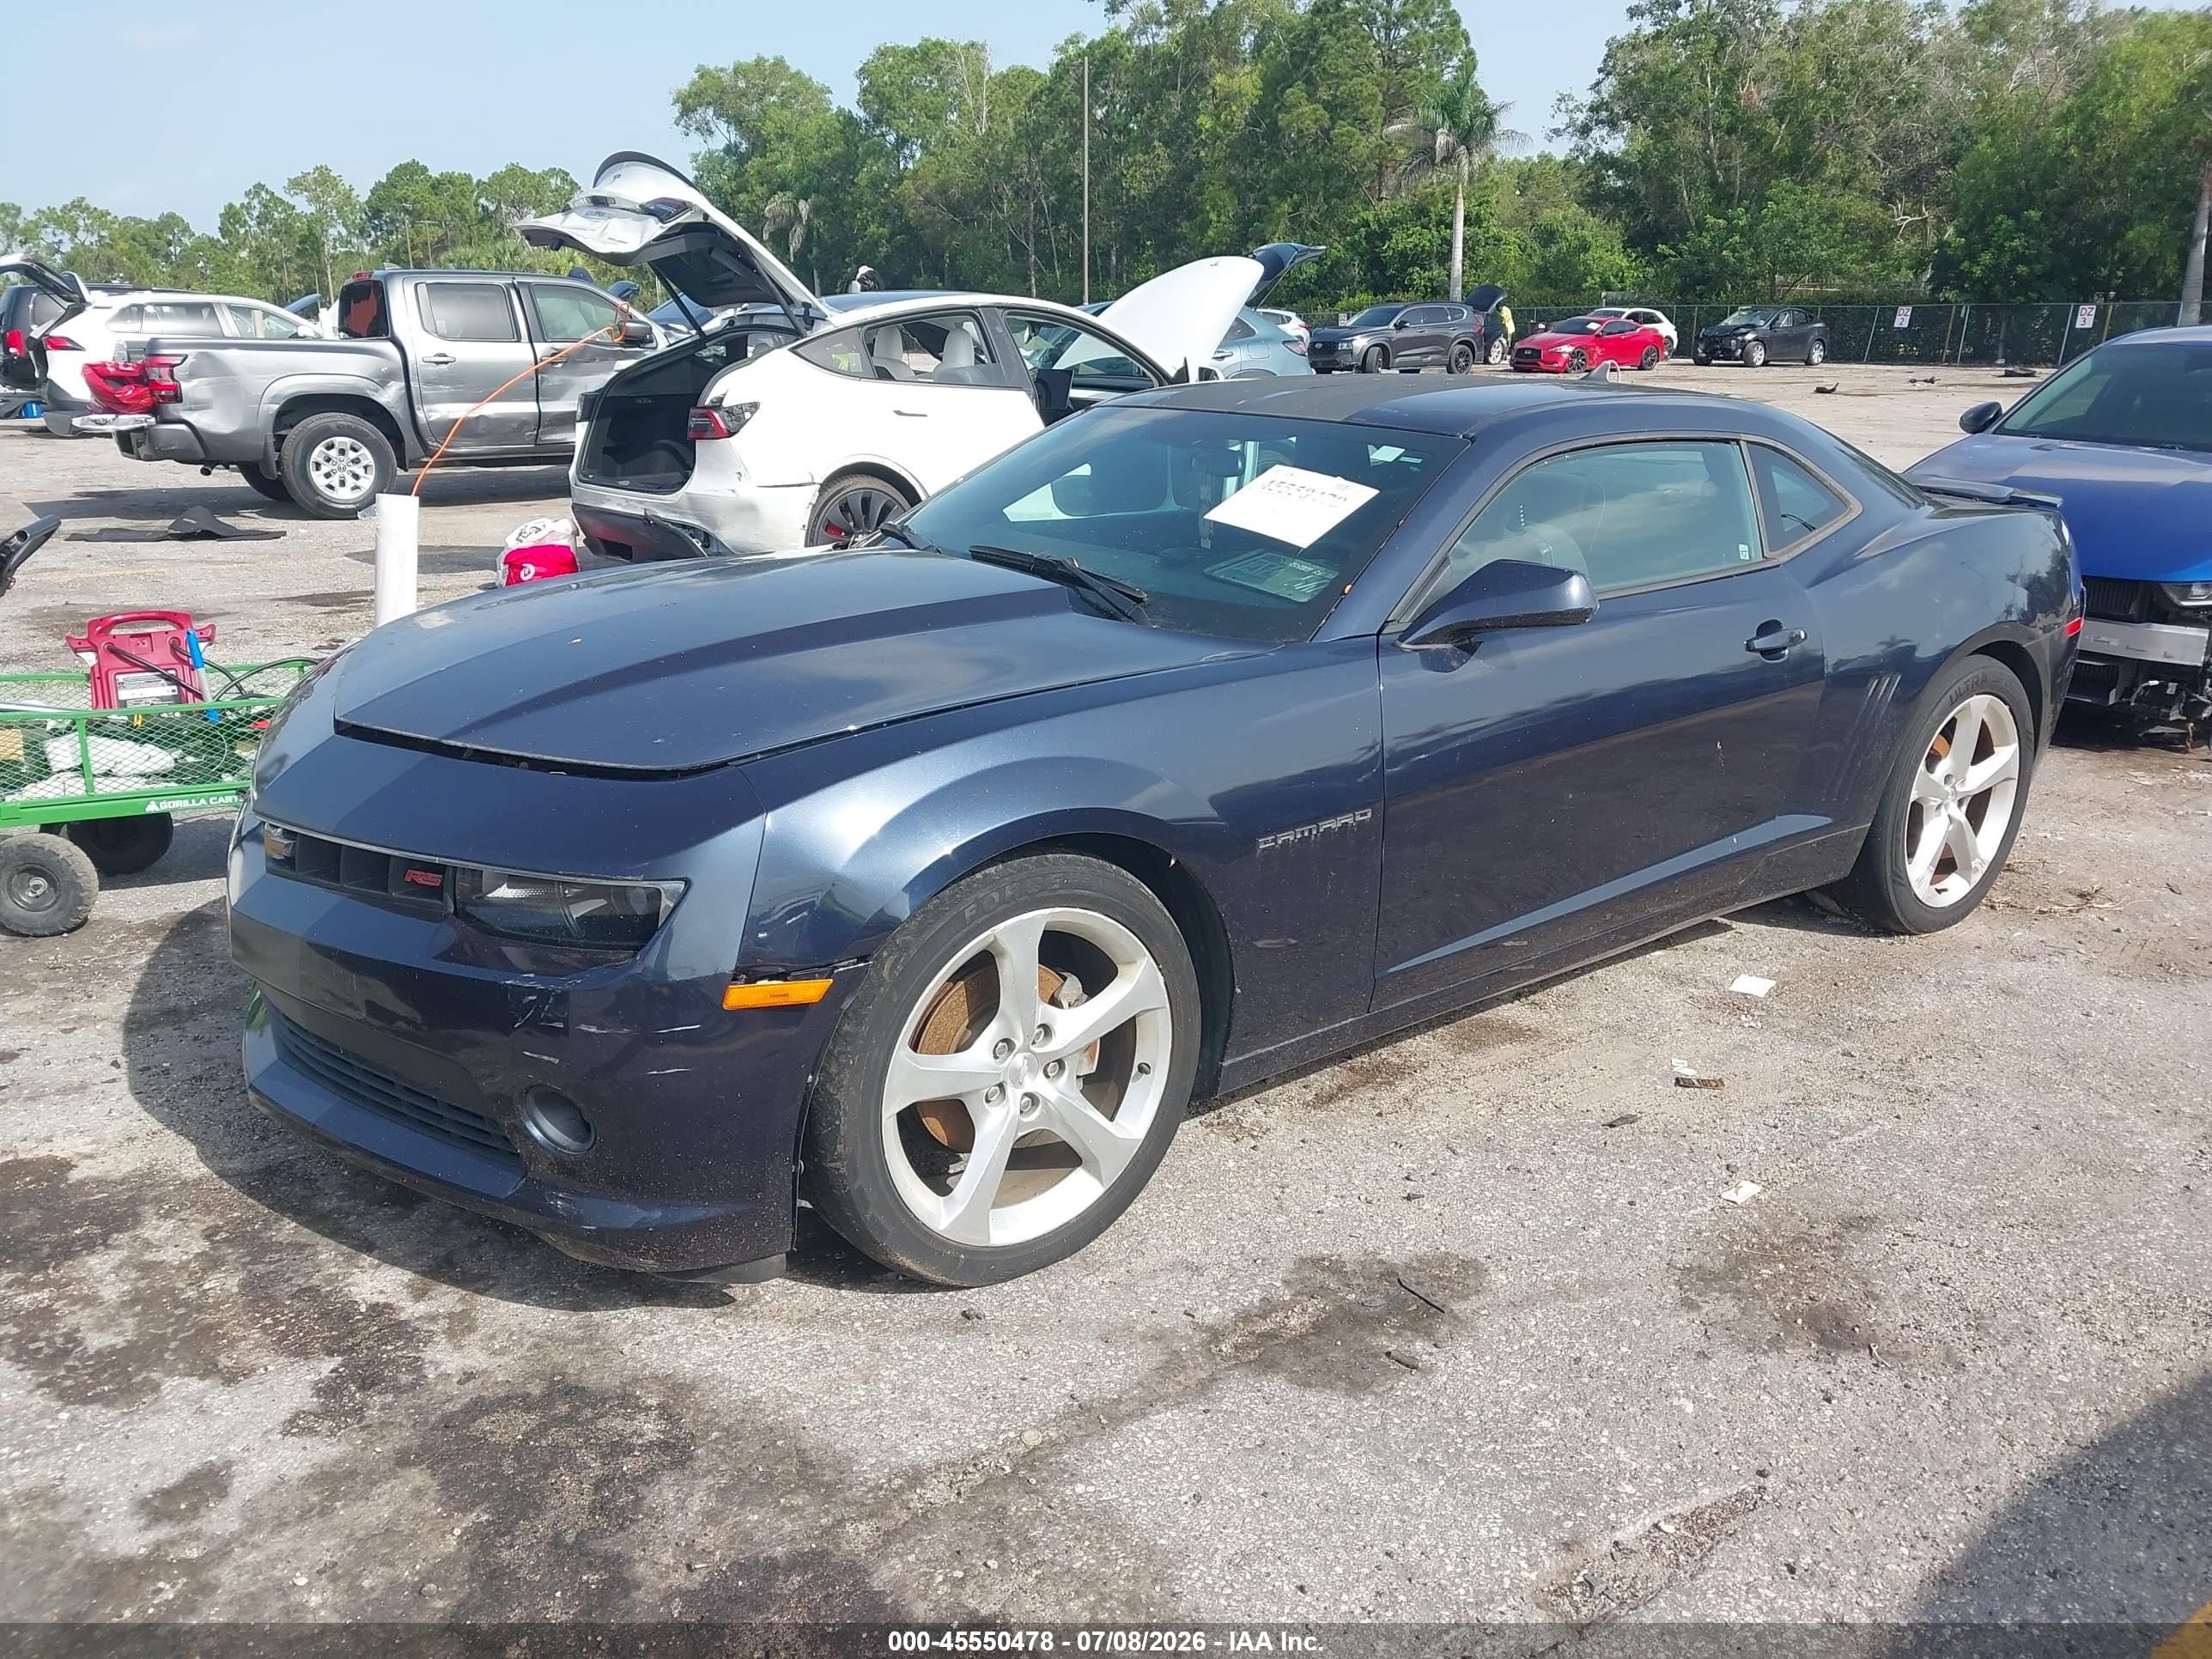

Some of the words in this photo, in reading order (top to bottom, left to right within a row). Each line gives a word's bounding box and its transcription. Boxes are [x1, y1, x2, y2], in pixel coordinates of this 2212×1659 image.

[1898, 308, 1911, 317] DZ
[2080, 307, 2095, 316] DZ
[1899, 318, 1905, 326] 2
[2081, 318, 2087, 326] 3
[1949, 672, 1988, 706] ULTRA
[160, 797, 208, 810] GORILLA
[209, 794, 244, 805] CART
[1256, 808, 1372, 850] CAMARO
[404, 869, 442, 886] RS
